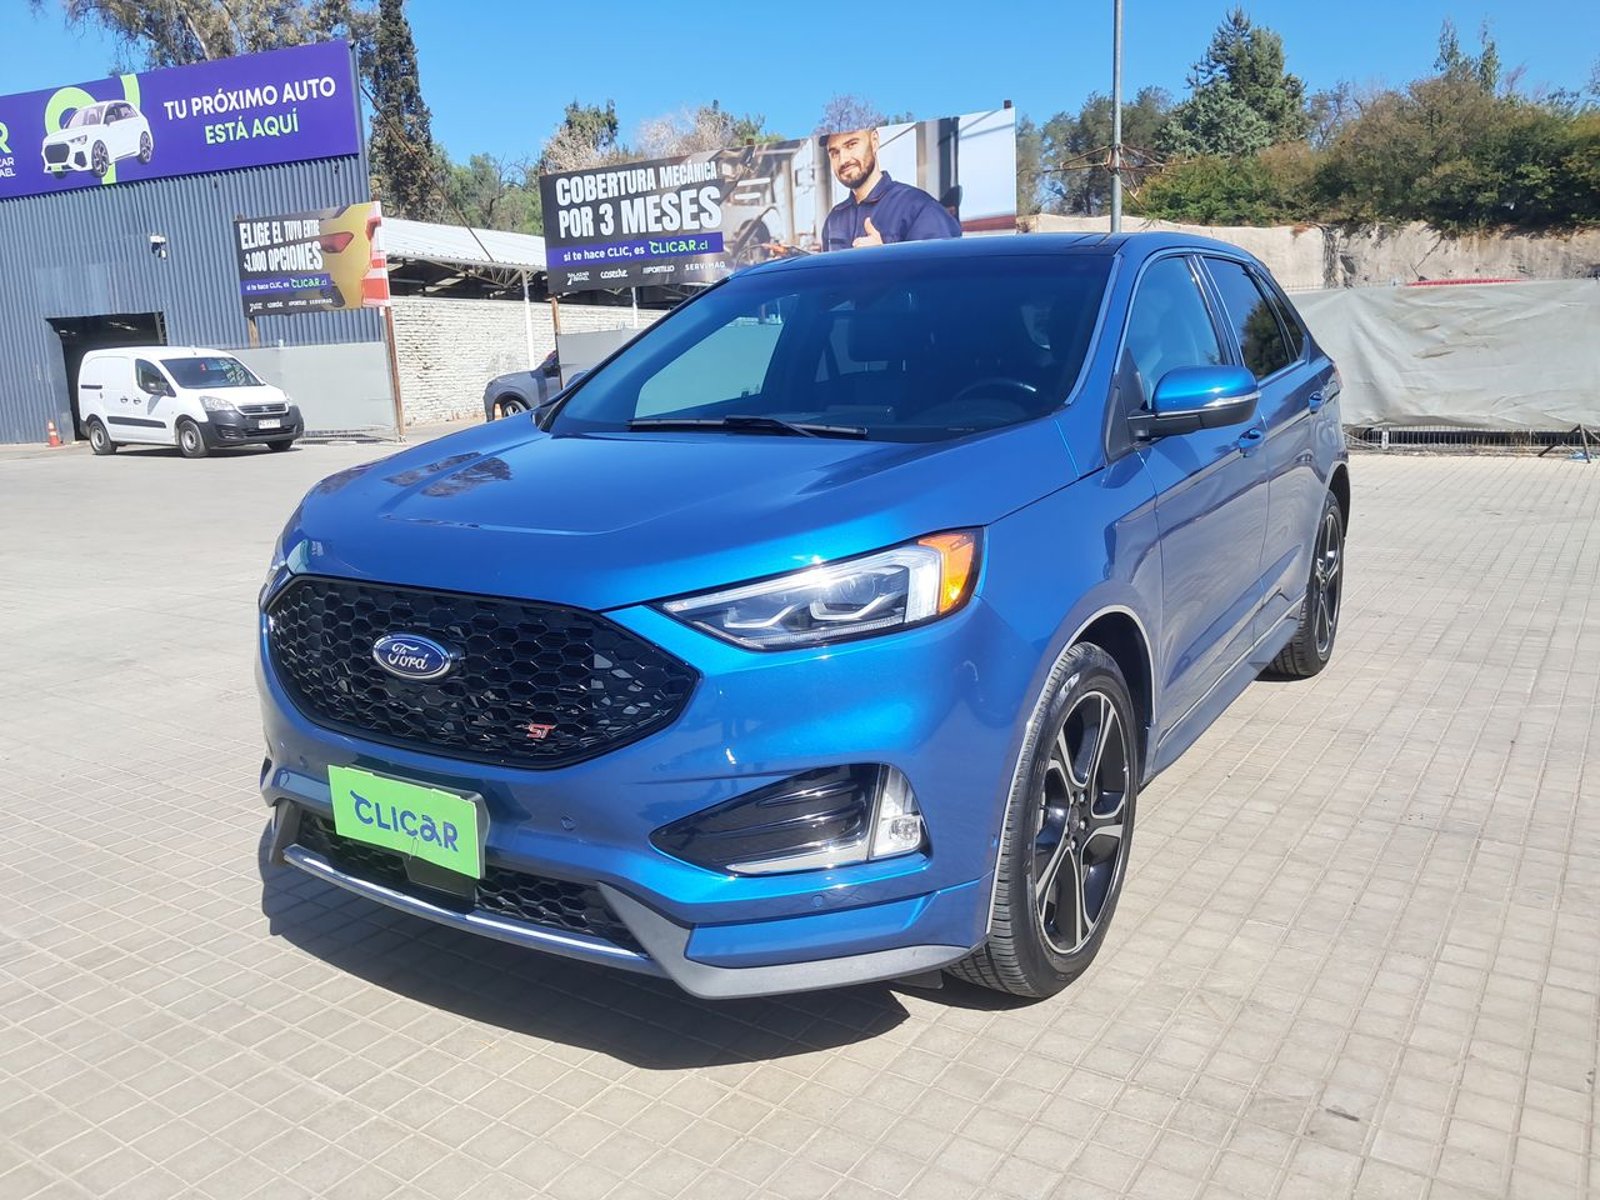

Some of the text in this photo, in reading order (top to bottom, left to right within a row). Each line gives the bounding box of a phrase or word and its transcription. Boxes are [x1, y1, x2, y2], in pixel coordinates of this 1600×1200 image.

[164, 76, 336, 121] TU PRÓXIMO AUTO
[204, 108, 299, 145] ESTÁ AQUÍ
[556, 160, 717, 206] COBERTURA MECÁNICA
[558, 186, 722, 239] POR 3 MESES
[239, 221, 271, 250] ELIGE
[272, 221, 283, 244] EL
[284, 220, 302, 241] TUYO
[268, 241, 323, 271] OPCIONES
[563, 252, 571, 262] si
[573, 251, 582, 260] te
[584, 250, 605, 260] hace
[607, 247, 632, 257] CLIC,
[634, 247, 645, 255] es
[388, 643, 430, 671] Ford
[526, 723, 556, 739] ST
